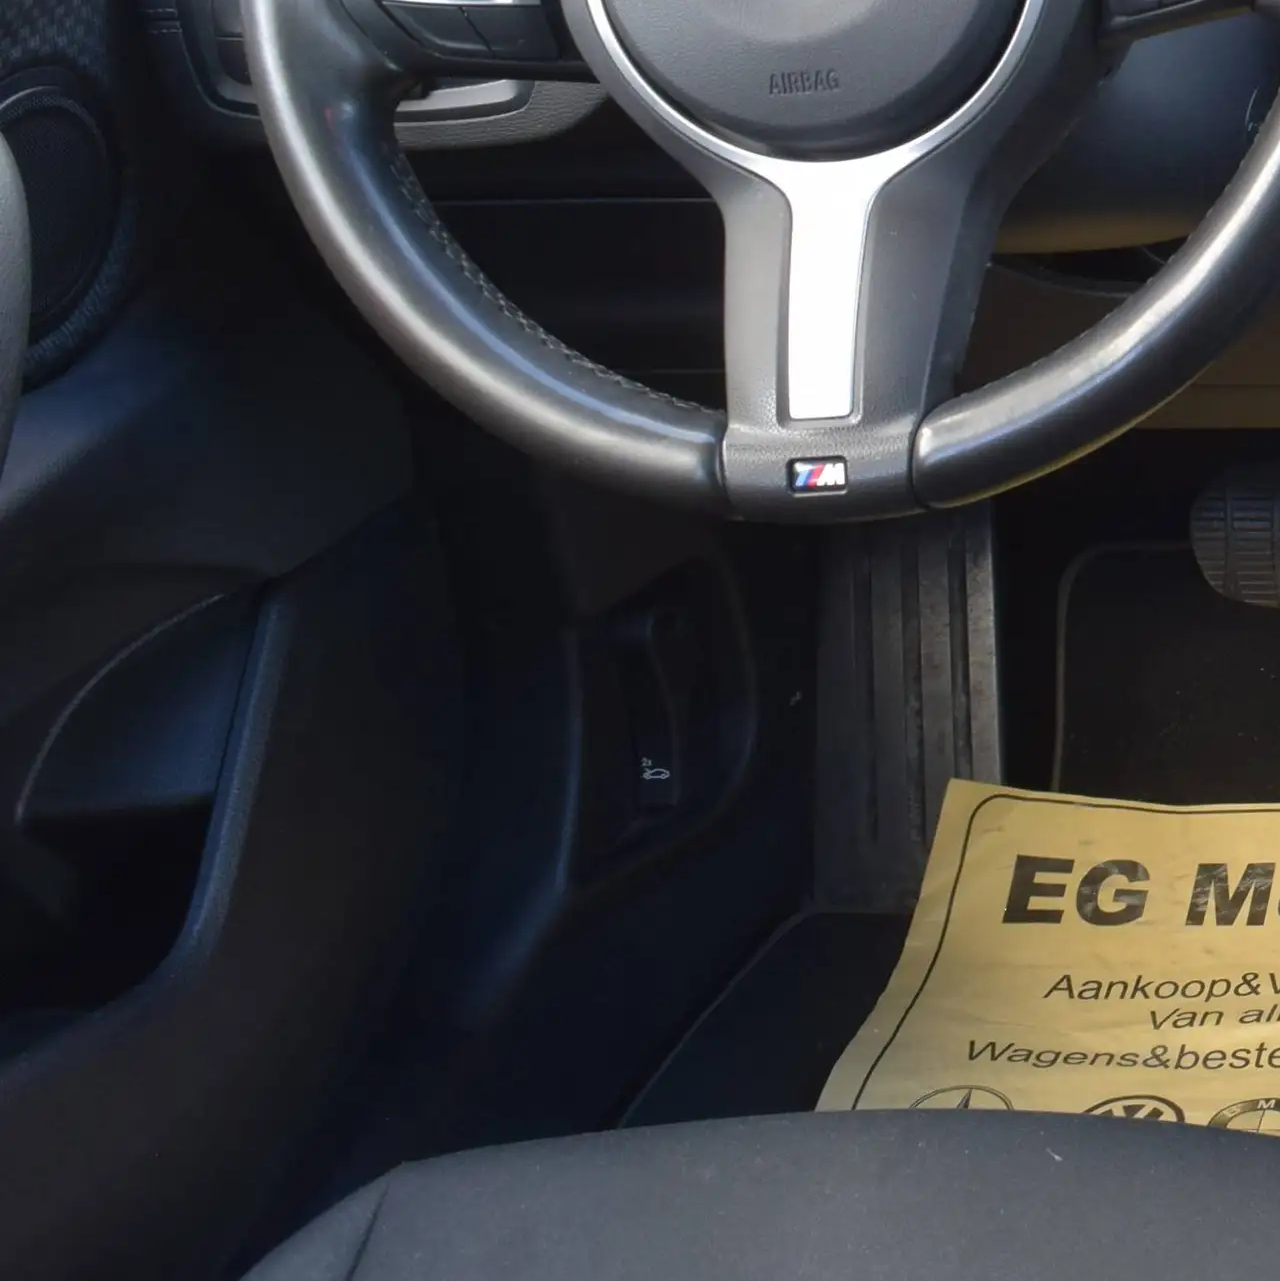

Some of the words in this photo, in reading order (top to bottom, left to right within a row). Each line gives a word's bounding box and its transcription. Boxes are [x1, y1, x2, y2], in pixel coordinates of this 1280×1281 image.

[769, 67, 840, 94] AIRBAG
[1001, 853, 1151, 926] EG
[1148, 1007, 1223, 1031] Van
